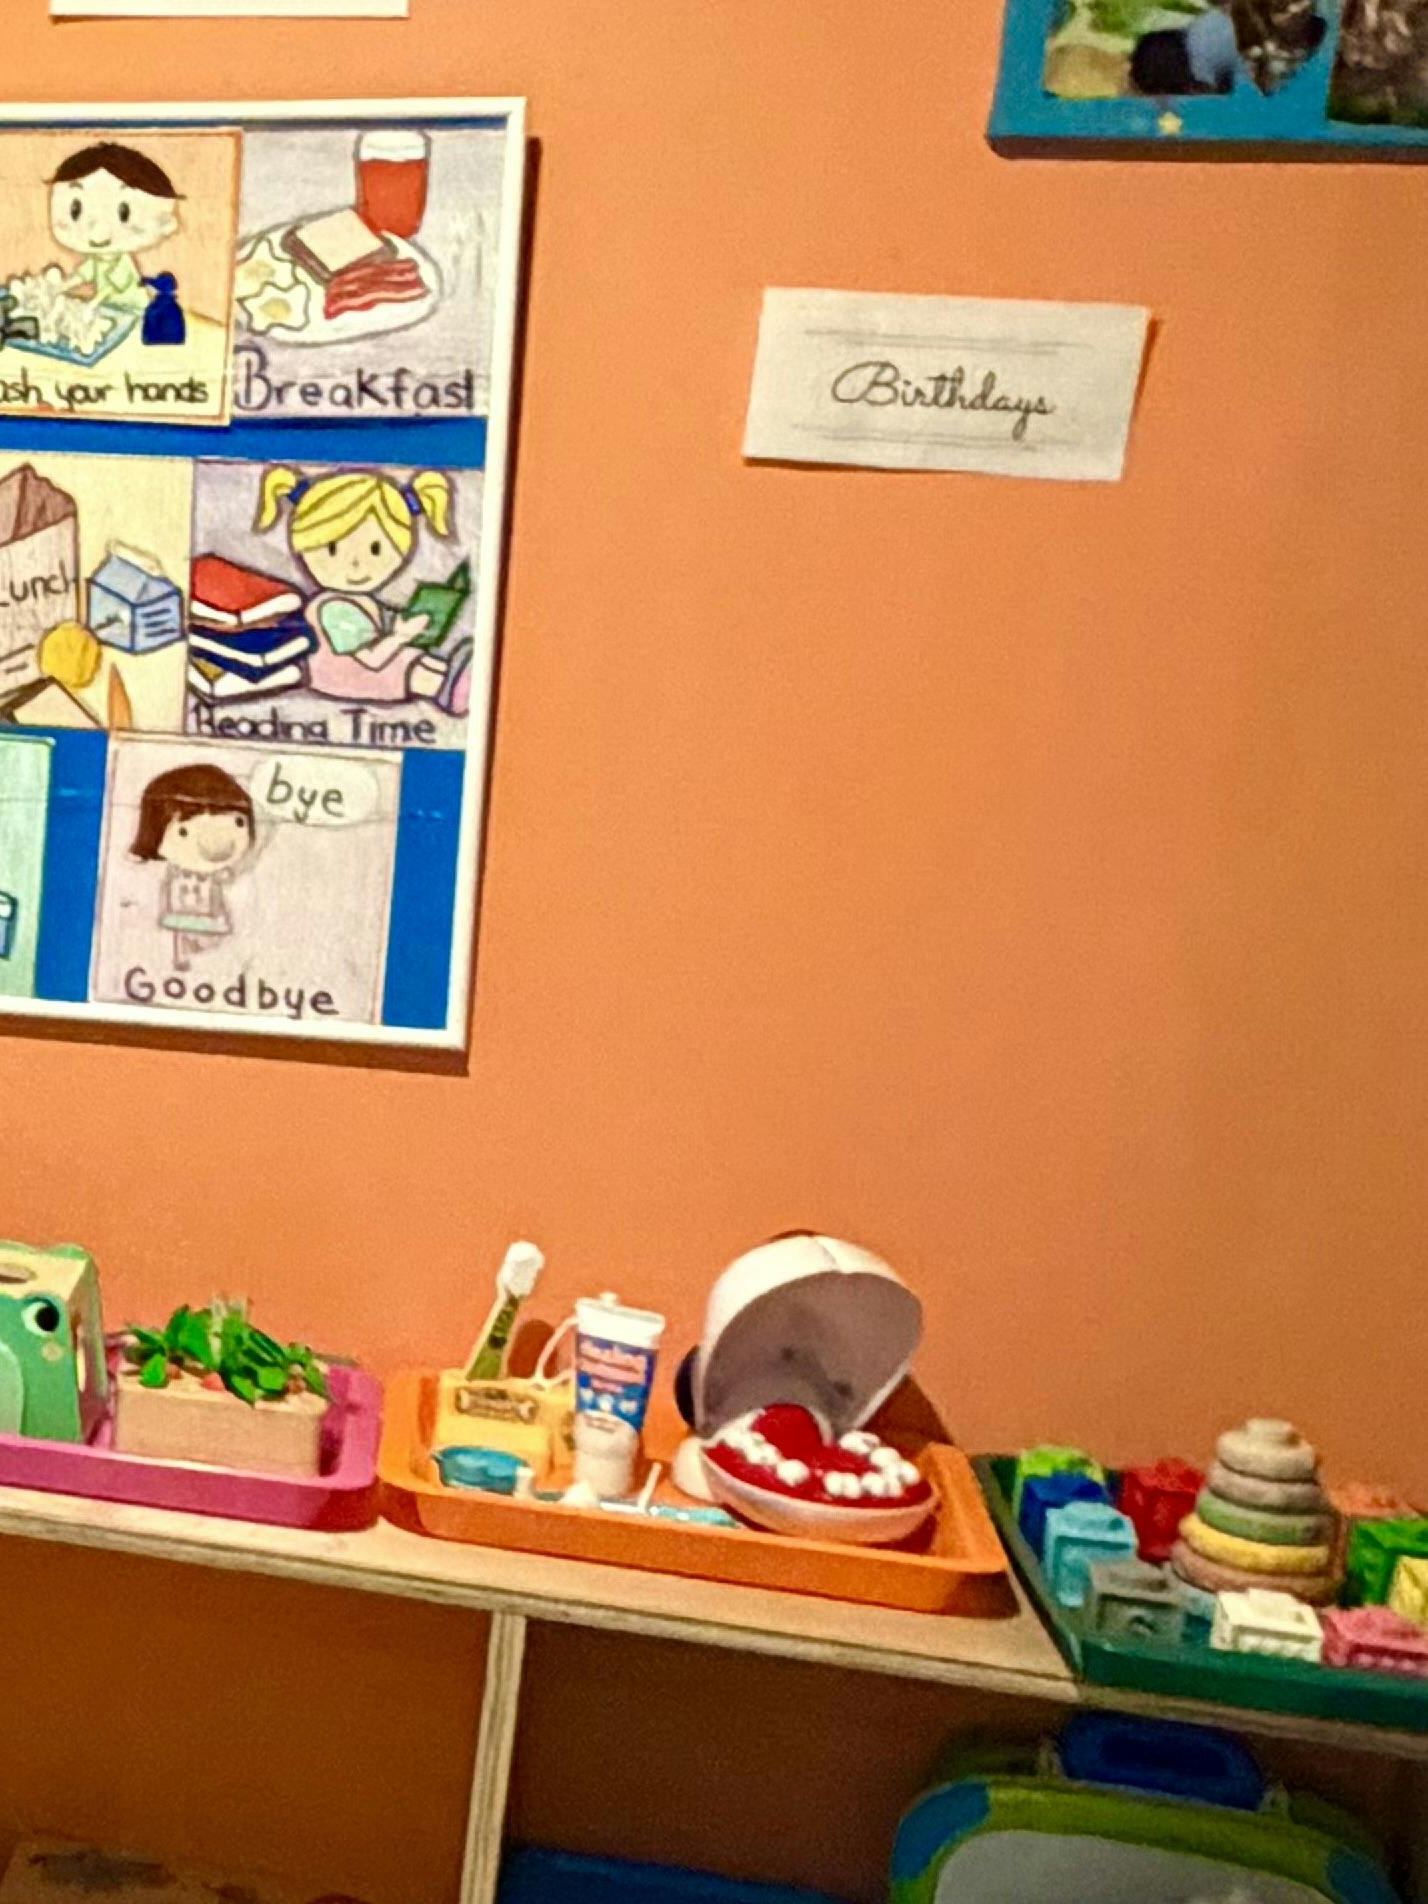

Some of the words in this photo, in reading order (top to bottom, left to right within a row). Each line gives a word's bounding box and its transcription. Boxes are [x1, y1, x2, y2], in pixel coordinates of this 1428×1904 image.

[52, 379, 112, 413] your
[124, 372, 209, 406] hands
[232, 346, 475, 412] Breakfast
[830, 360, 1058, 440] Birthdays
[193, 705, 329, 744] Reading
[341, 707, 436, 744] Time
[267, 762, 346, 822] bye
[124, 969, 339, 1021] Goodbye
